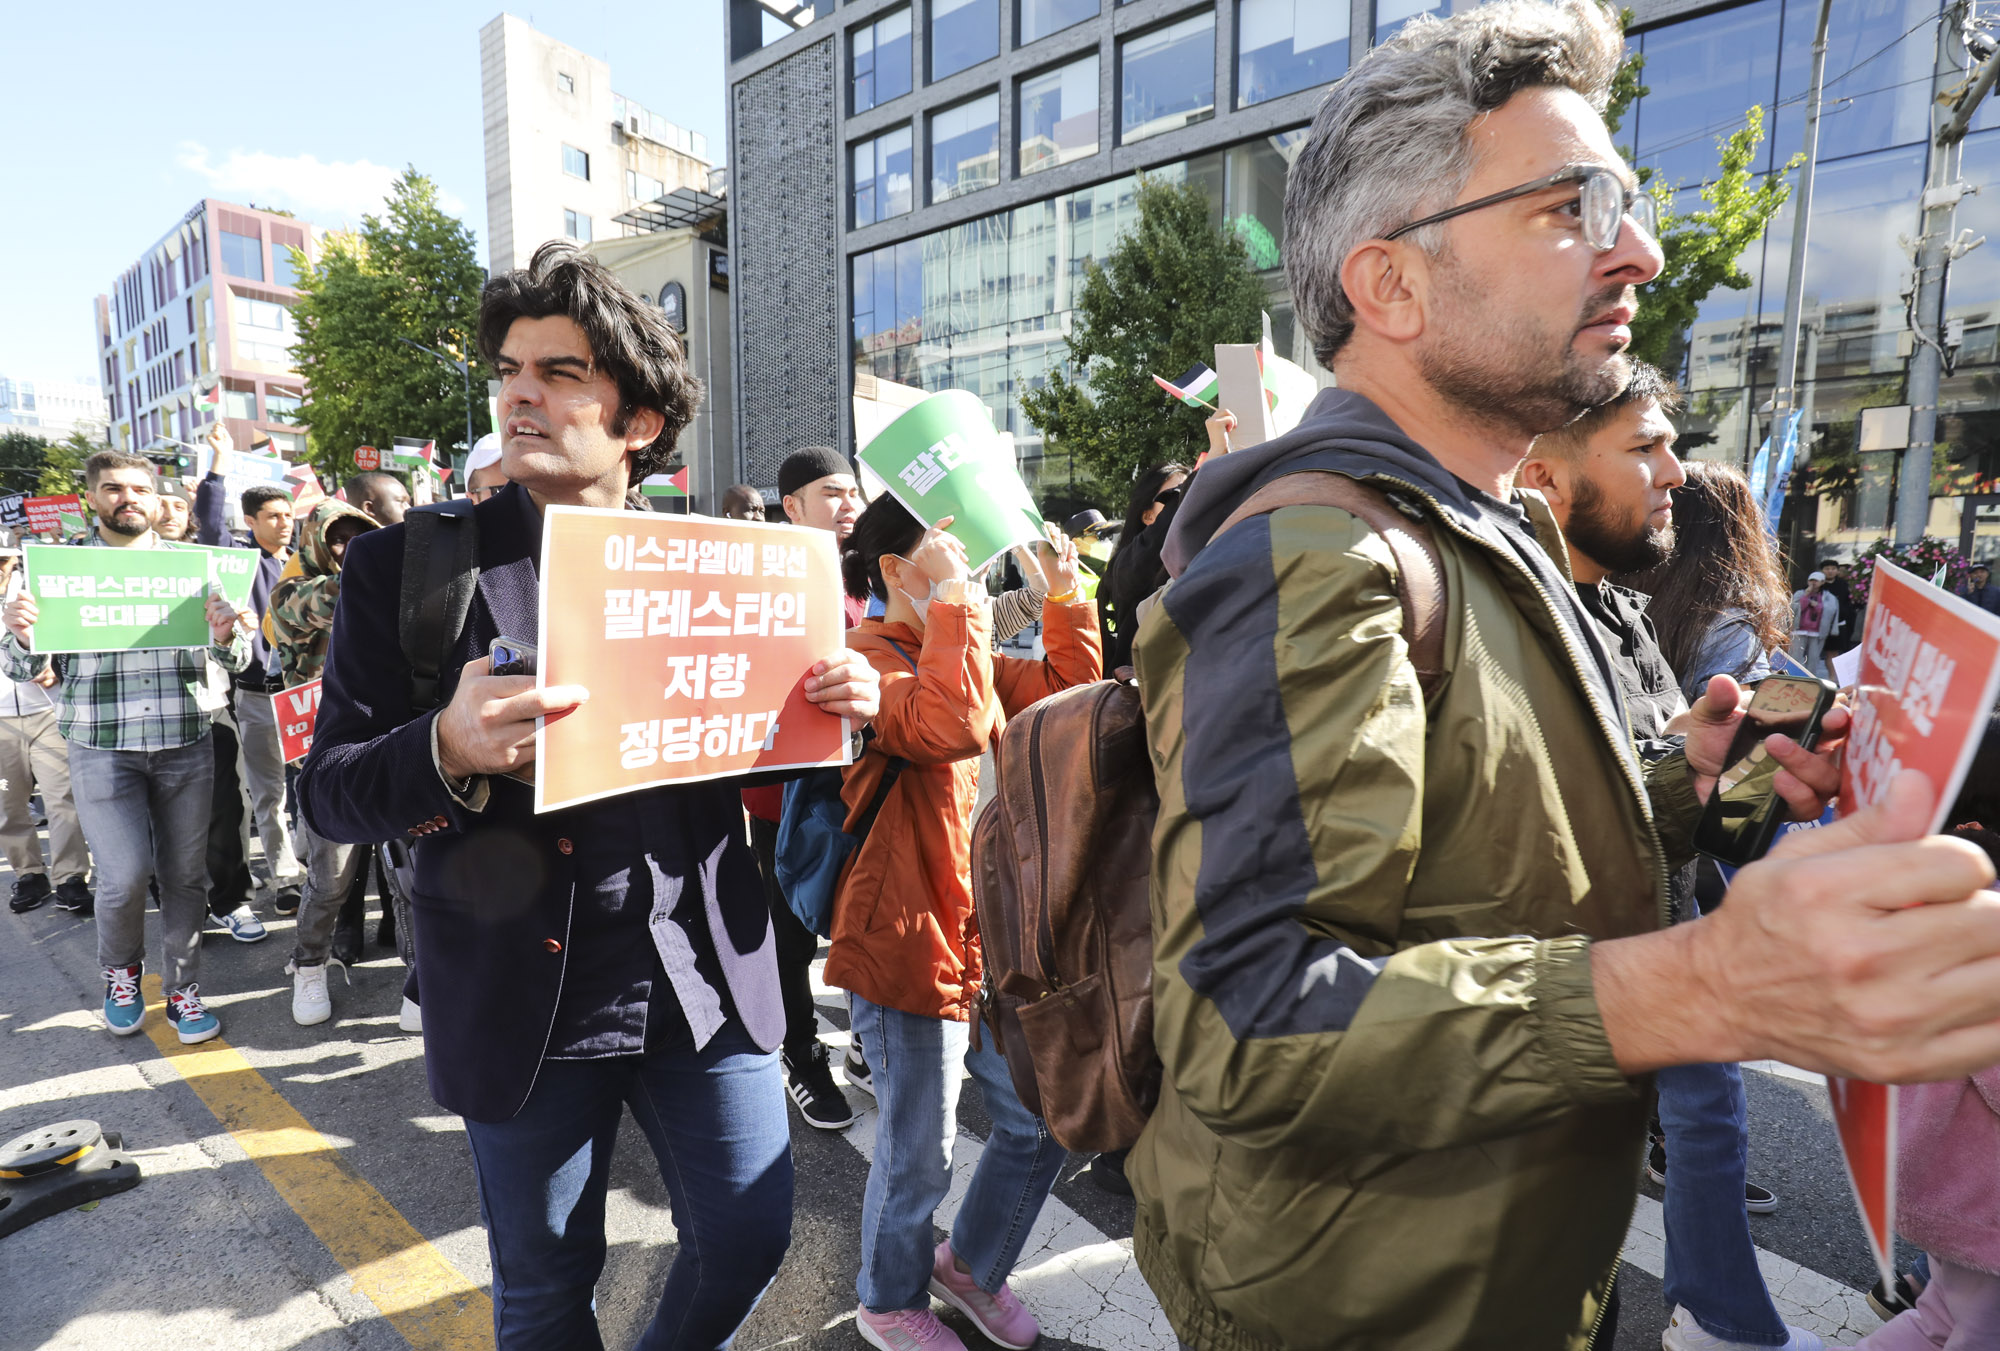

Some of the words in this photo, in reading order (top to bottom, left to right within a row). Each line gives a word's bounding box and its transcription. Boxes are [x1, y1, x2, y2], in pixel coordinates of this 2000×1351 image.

[357, 460, 377, 468] STOP
[358, 448, 378, 460] 정지
[604, 534, 753, 577] 이스라엘에
[761, 543, 808, 578] 맞선
[37, 575, 202, 599] 팔레스타인에
[79, 604, 169, 628] 연대를!
[603, 588, 807, 641] 팔레스타인
[664, 652, 751, 701] 저항
[288, 685, 323, 716] Vi
[285, 721, 309, 737] to
[619, 710, 780, 771] 정당하다
[302, 734, 314, 750] R
